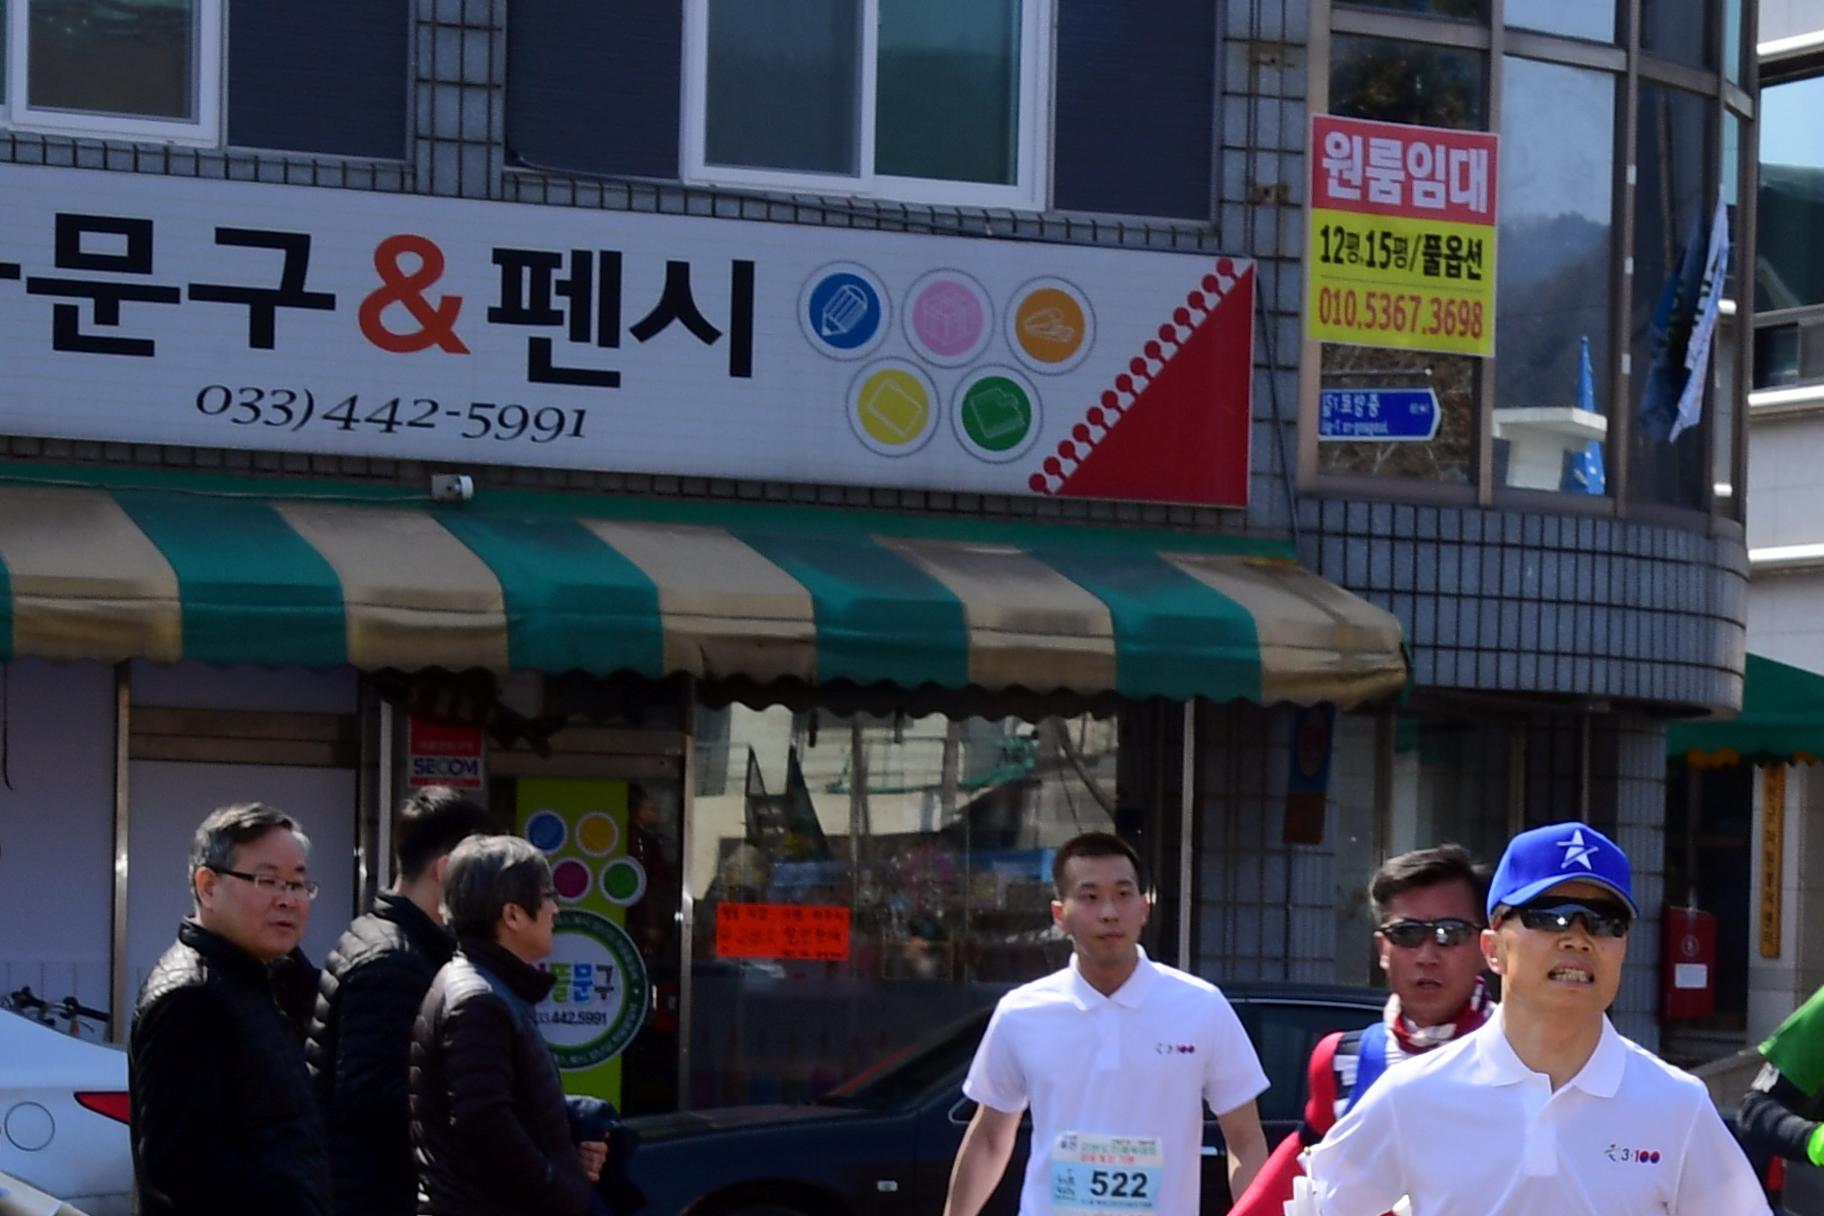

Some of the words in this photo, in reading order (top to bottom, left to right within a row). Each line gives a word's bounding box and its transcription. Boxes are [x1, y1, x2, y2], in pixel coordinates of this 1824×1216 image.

[1322, 131, 1488, 214] 원룸임대
[1319, 286, 1484, 340] 010.5367.3698
[414, 757, 479, 776] SECOM
[1089, 1170, 1149, 1199] 522
